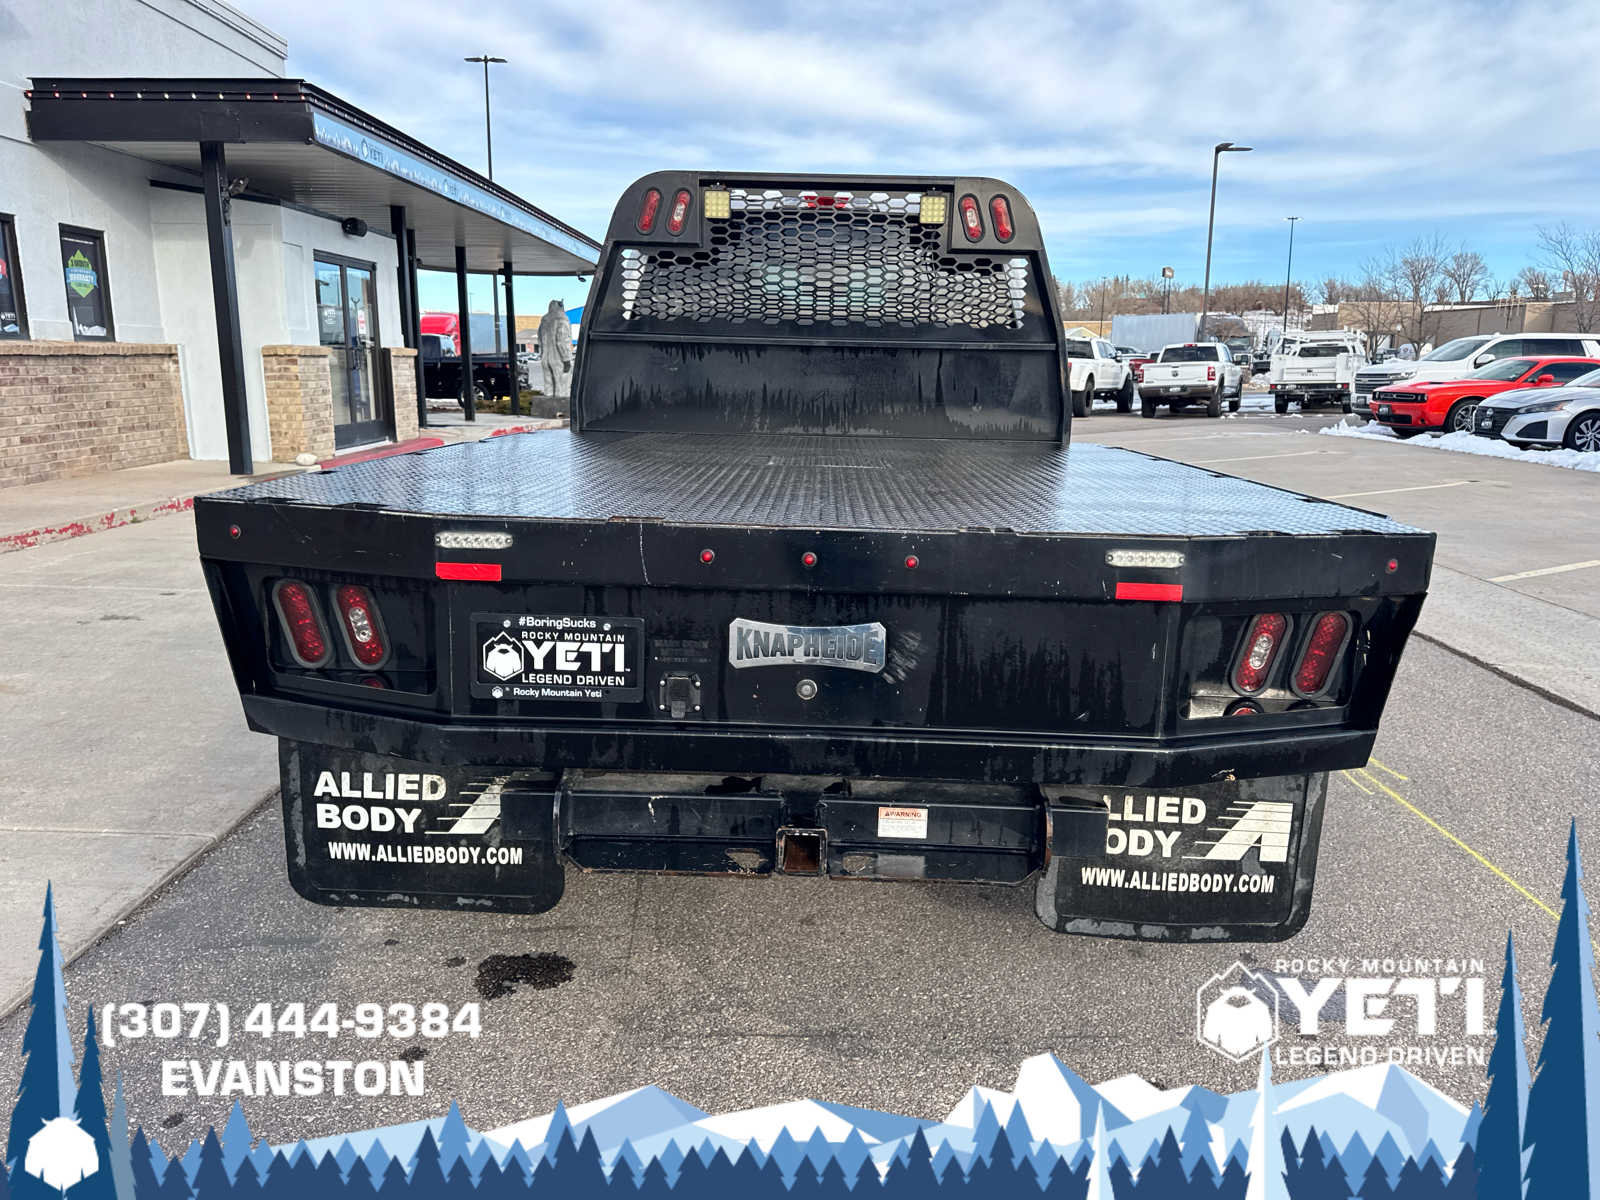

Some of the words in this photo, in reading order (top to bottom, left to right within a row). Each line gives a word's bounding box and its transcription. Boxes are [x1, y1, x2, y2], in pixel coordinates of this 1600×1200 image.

[518, 616, 597, 630] #BoringSucks
[521, 631, 559, 641] ROCKY
[564, 632, 625, 643] MOUNTAIN
[521, 639, 625, 673] YETI
[736, 626, 879, 665] KNAPHEIDE
[513, 687, 540, 699] Rocky
[541, 688, 583, 698] Mountain
[584, 688, 602, 699] Yeti
[521, 673, 572, 685] LEGEND
[577, 674, 625, 686] DRIVEN
[313, 771, 447, 801] ALLIED
[316, 803, 422, 834] BODY
[1103, 794, 1207, 824] LLIED
[328, 841, 523, 865] WWW.ALLIEDBODY.COM
[1106, 828, 1182, 858] ODY
[1081, 866, 1275, 893] WWW.ALLIEDBODY.COM
